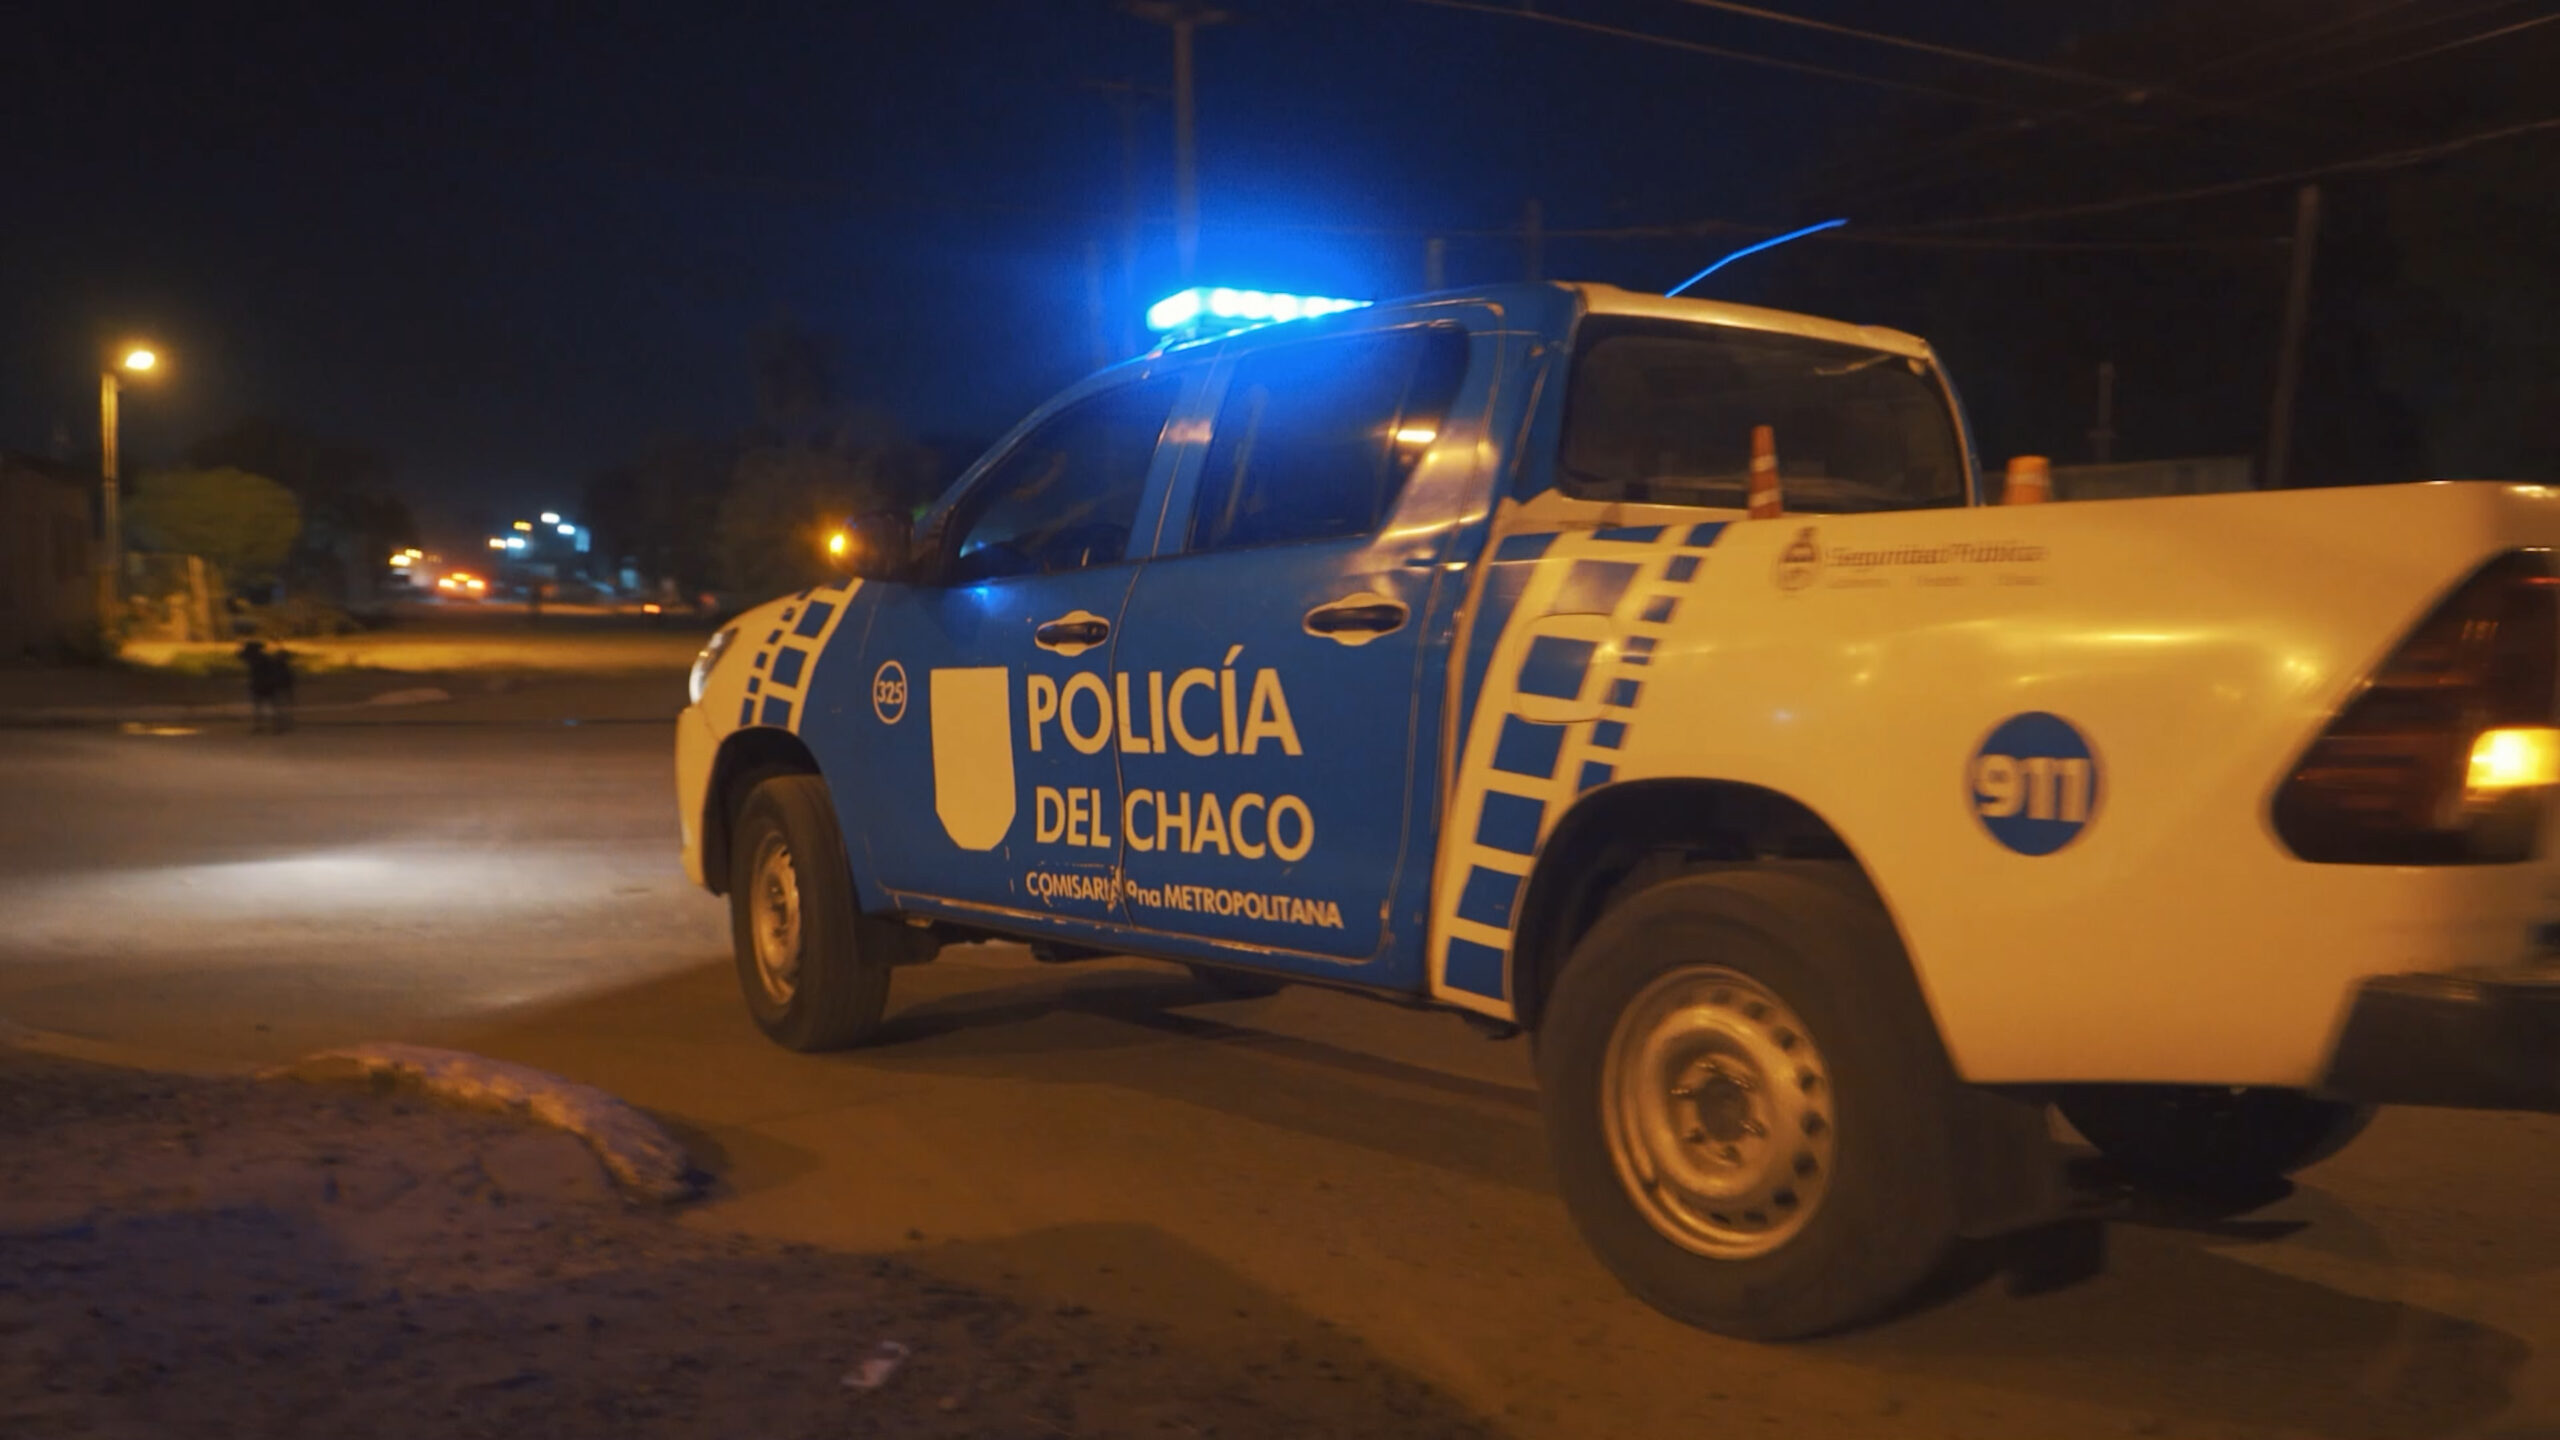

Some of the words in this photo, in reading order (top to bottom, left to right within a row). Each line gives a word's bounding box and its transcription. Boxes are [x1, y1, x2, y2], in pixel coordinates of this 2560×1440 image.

[878, 681, 904, 704] 325
[1027, 644, 1303, 757] POLICÍA
[1975, 753, 2090, 822] 911
[1035, 786, 1111, 848] DEL
[1124, 789, 1315, 862] CHACO
[1164, 883, 1344, 930] METROPOLITANA
